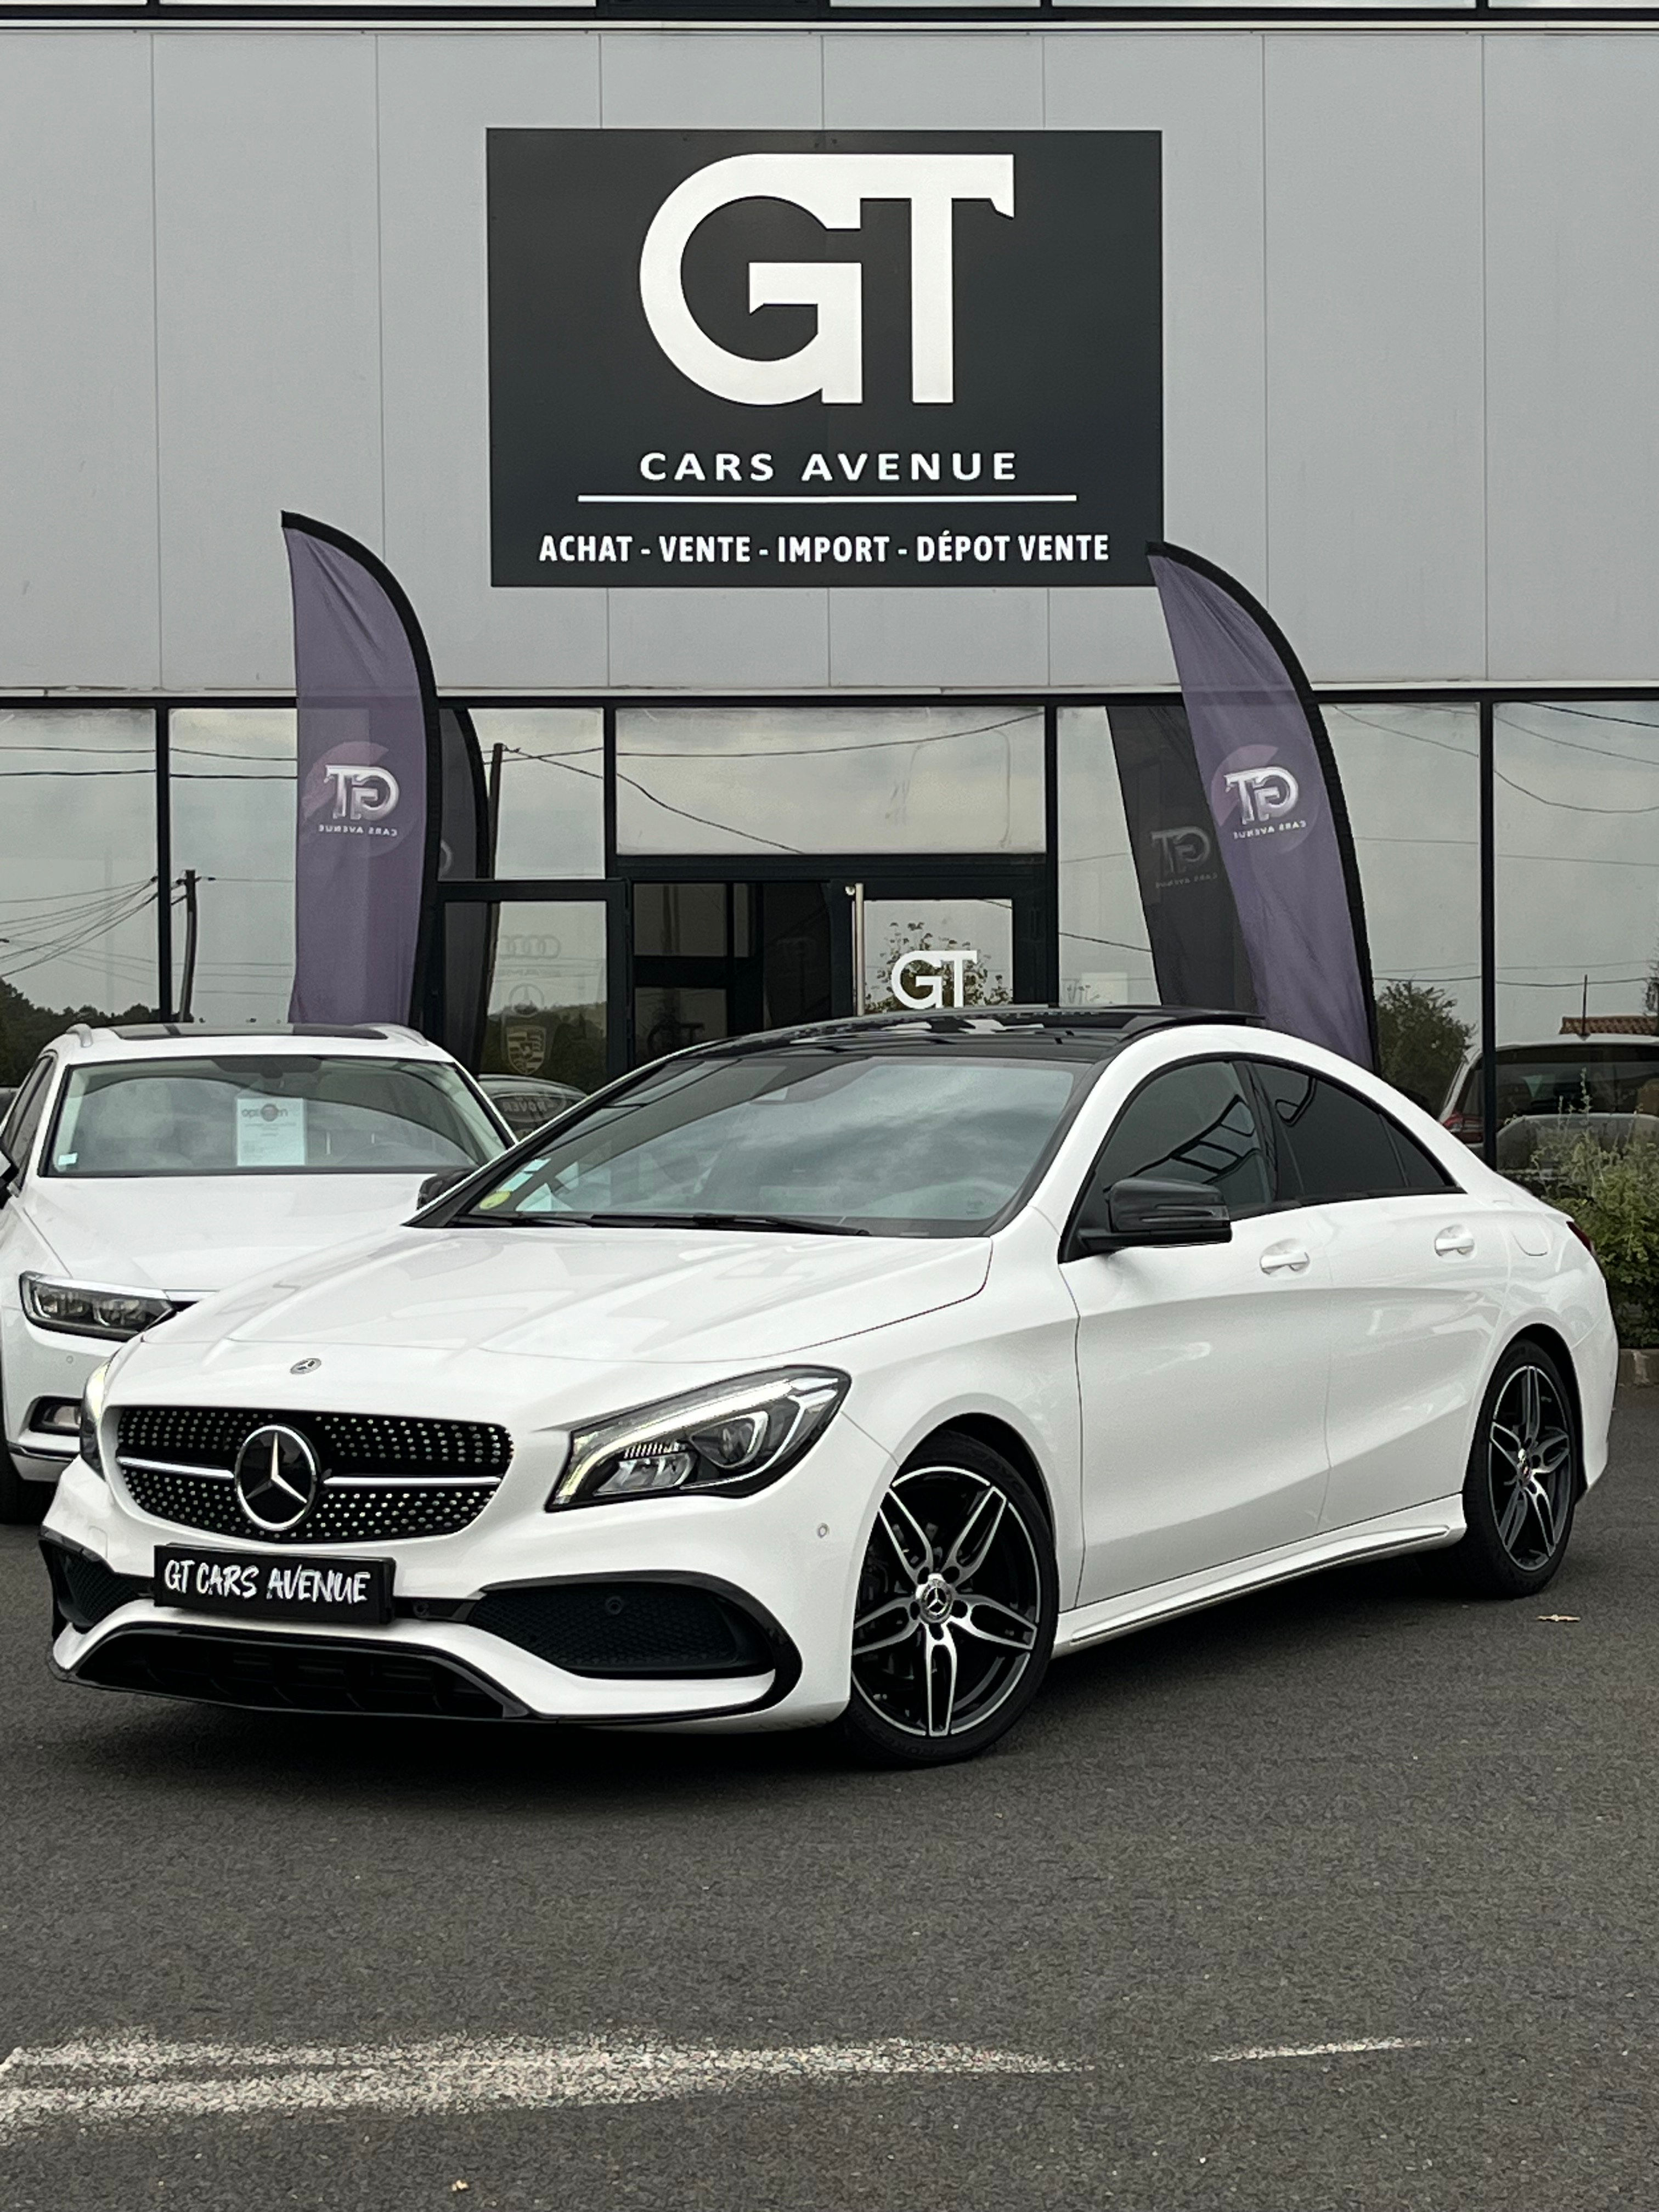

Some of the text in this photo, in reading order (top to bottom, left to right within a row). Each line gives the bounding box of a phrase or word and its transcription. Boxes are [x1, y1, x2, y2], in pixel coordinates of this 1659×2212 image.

[640, 154, 1014, 405] GT
[640, 452, 1015, 481] CARS AVENUE
[539, 535, 633, 562] ACHAT
[659, 535, 751, 562] VENTE
[778, 536, 890, 562] IMPORT
[917, 530, 1011, 562] DÉPOT
[1018, 534, 1109, 561] VENTE
[891, 950, 978, 1009] GT
[165, 1560, 371, 1604] GT CARS AVENUE
